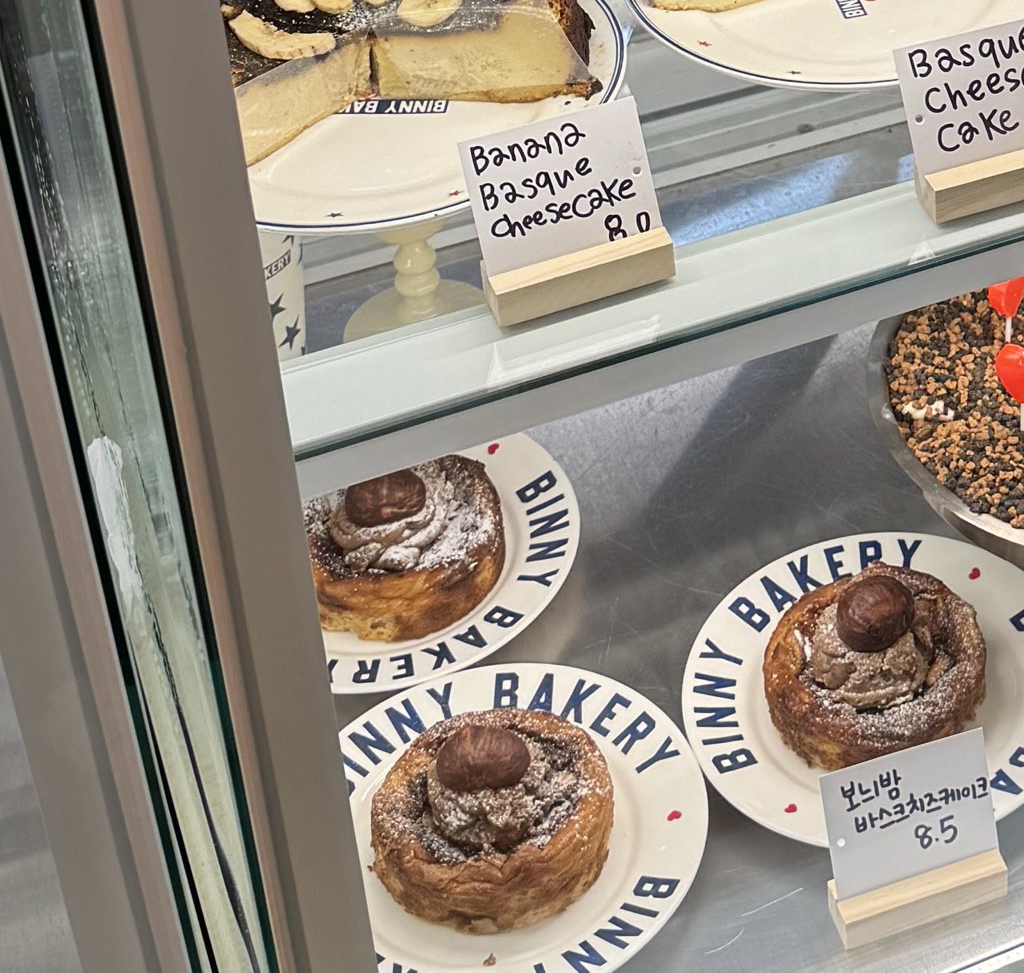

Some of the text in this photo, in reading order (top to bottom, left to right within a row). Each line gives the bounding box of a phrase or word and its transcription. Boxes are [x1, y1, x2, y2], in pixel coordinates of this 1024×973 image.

[385, 100, 447, 114] BINNY
[937, 108, 1019, 152] Cake
[470, 122, 586, 176] Banana
[479, 157, 593, 211] Basque
[515, 470, 571, 588] BINNY
[693, 539, 923, 775] BINNY BAKERY
[342, 672, 681, 798] INNY BAKERY
[854, 777, 989, 833] 바스크치즈케이크
[914, 814, 958, 849] 8.5
[533, 875, 681, 973] BINN
